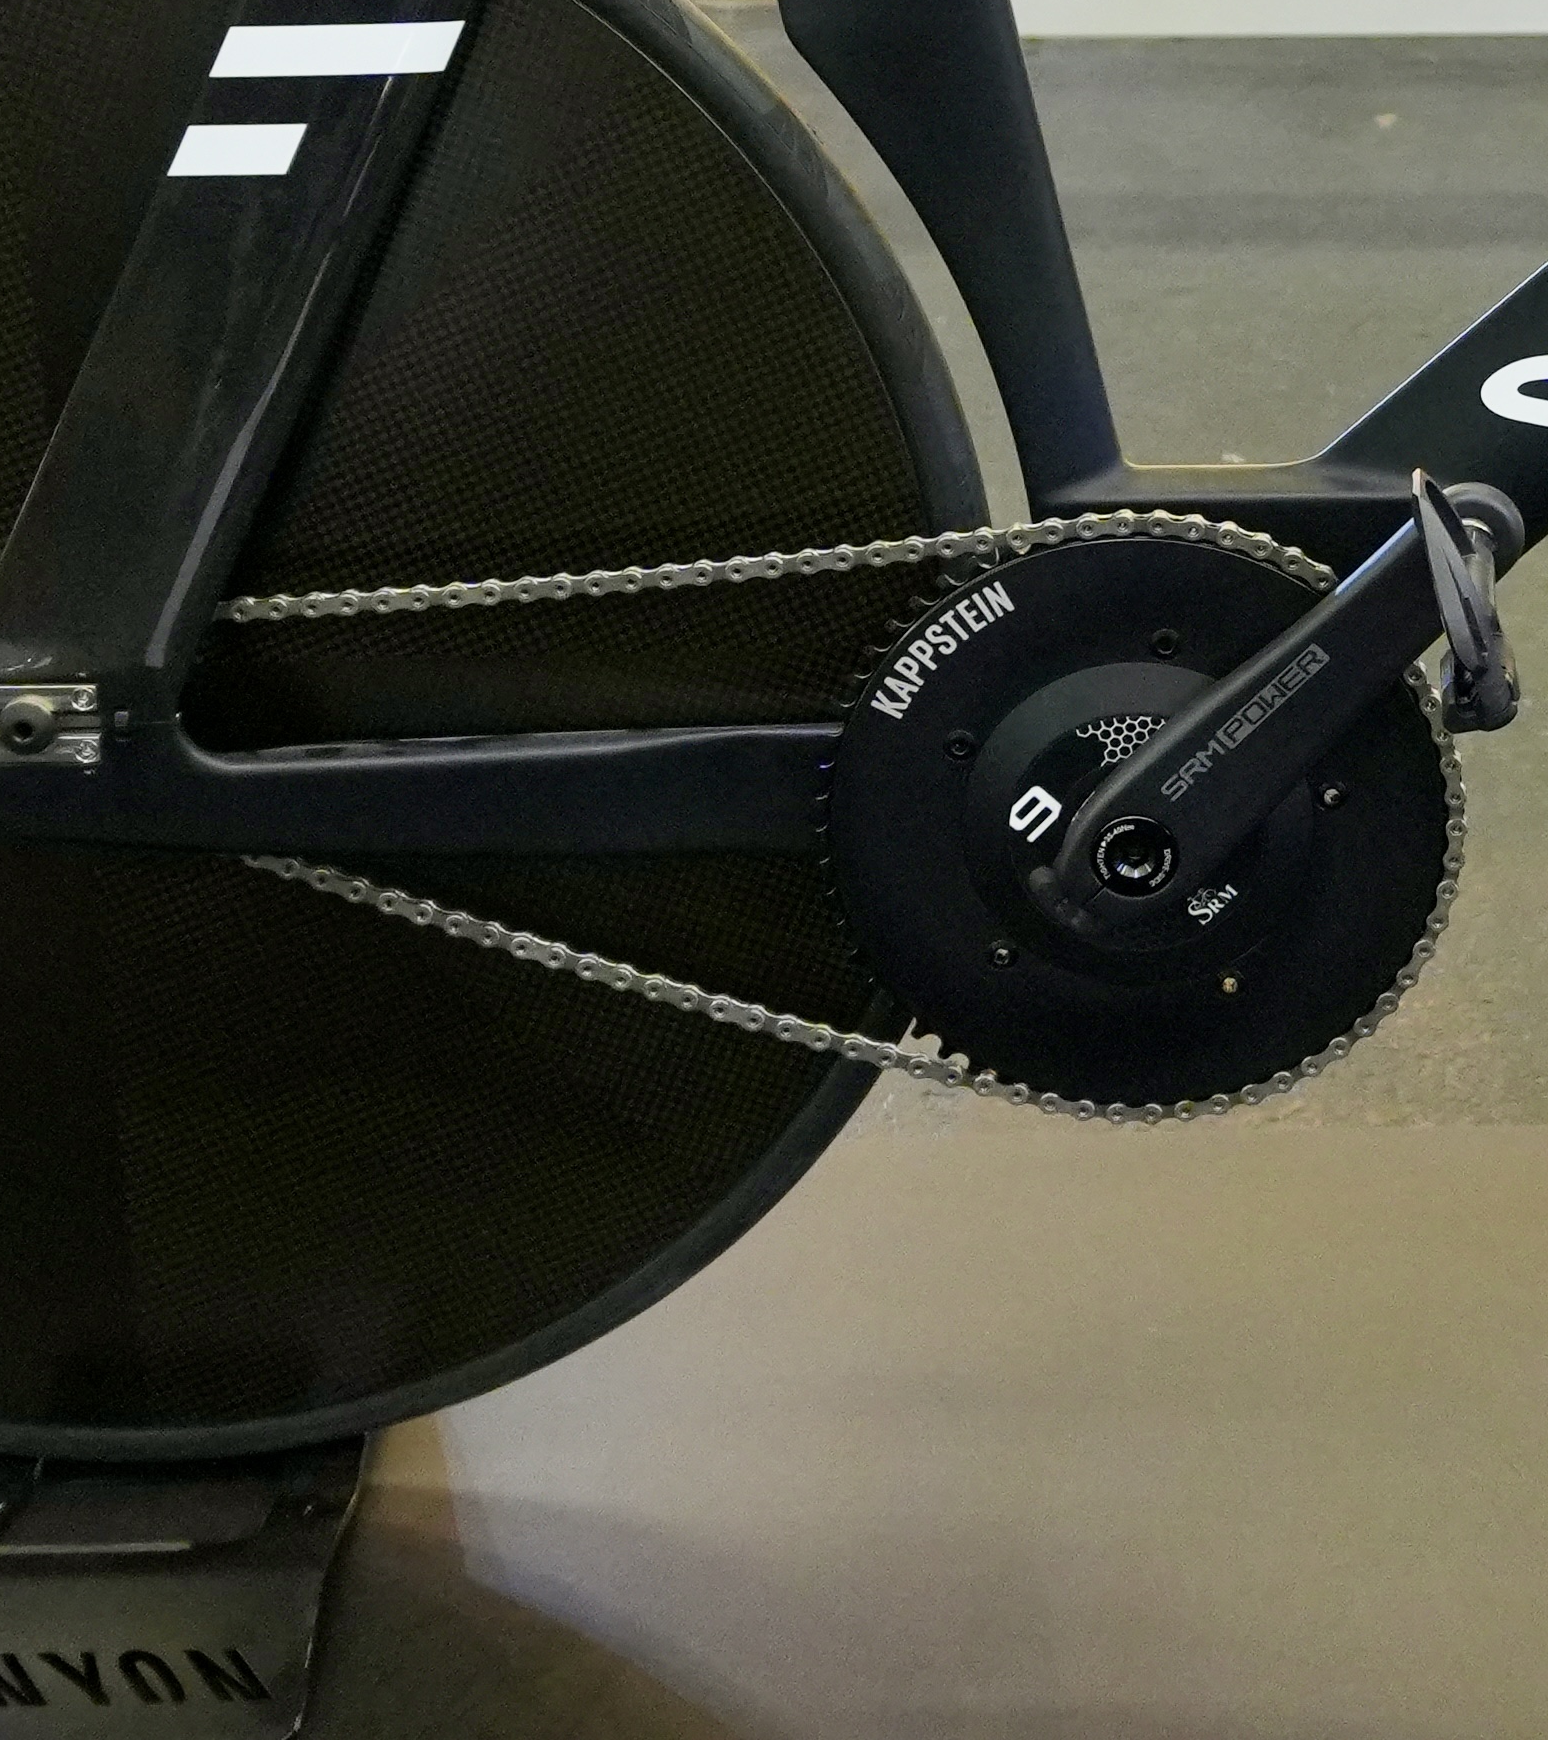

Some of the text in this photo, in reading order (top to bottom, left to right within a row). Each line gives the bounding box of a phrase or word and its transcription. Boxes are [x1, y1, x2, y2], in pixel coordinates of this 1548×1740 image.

[870, 580, 1015, 720] KAPPSTEIN
[1160, 645, 1328, 801] SRM POWER
[1187, 883, 1239, 926] SRM
